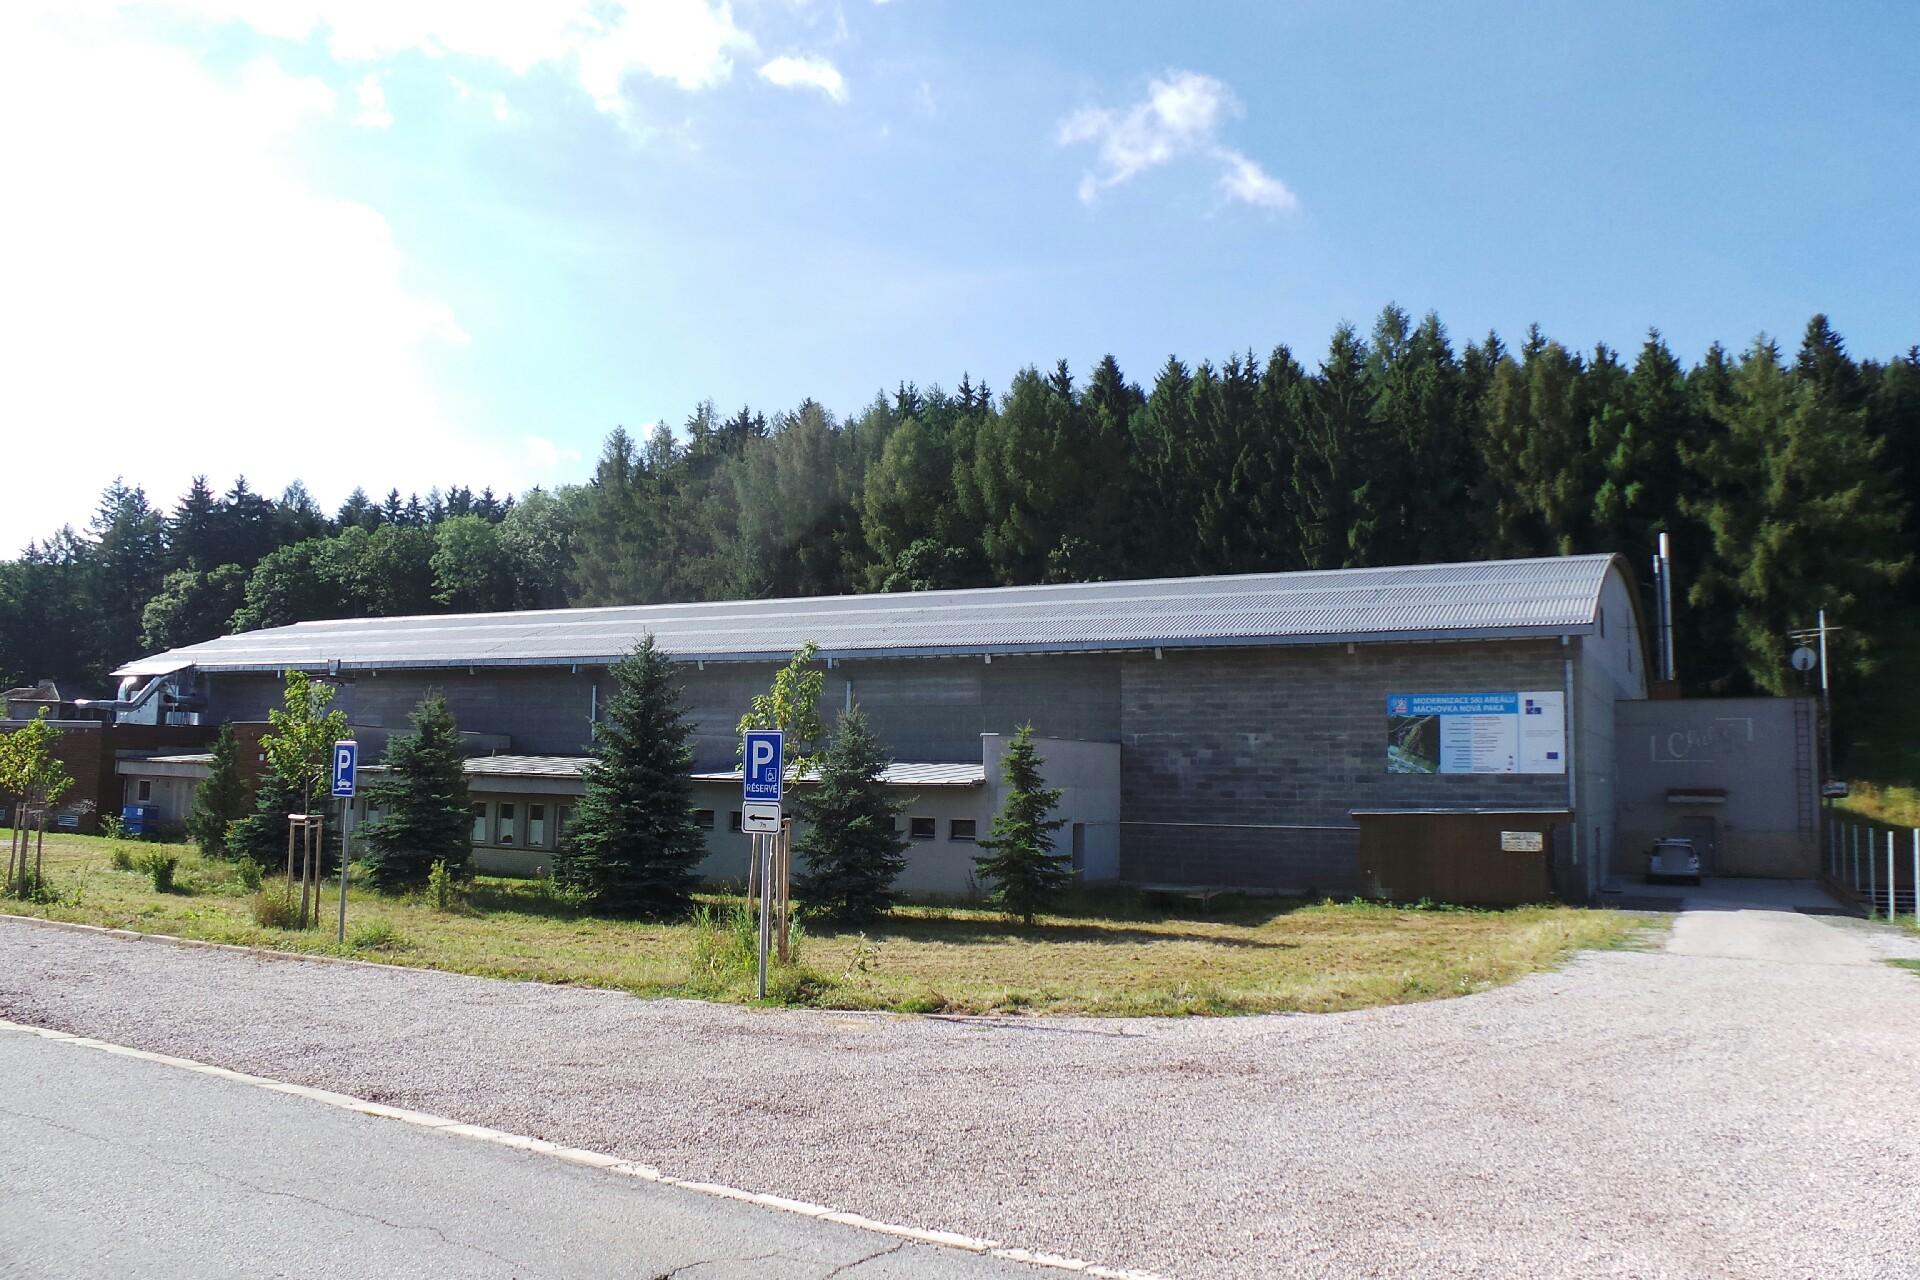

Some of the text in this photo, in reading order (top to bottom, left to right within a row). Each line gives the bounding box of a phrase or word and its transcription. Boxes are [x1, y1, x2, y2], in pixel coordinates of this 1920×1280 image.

[338, 750, 350, 779] P
[752, 740, 773, 779] P
[746, 782, 777, 794] RÉSERVÉ
